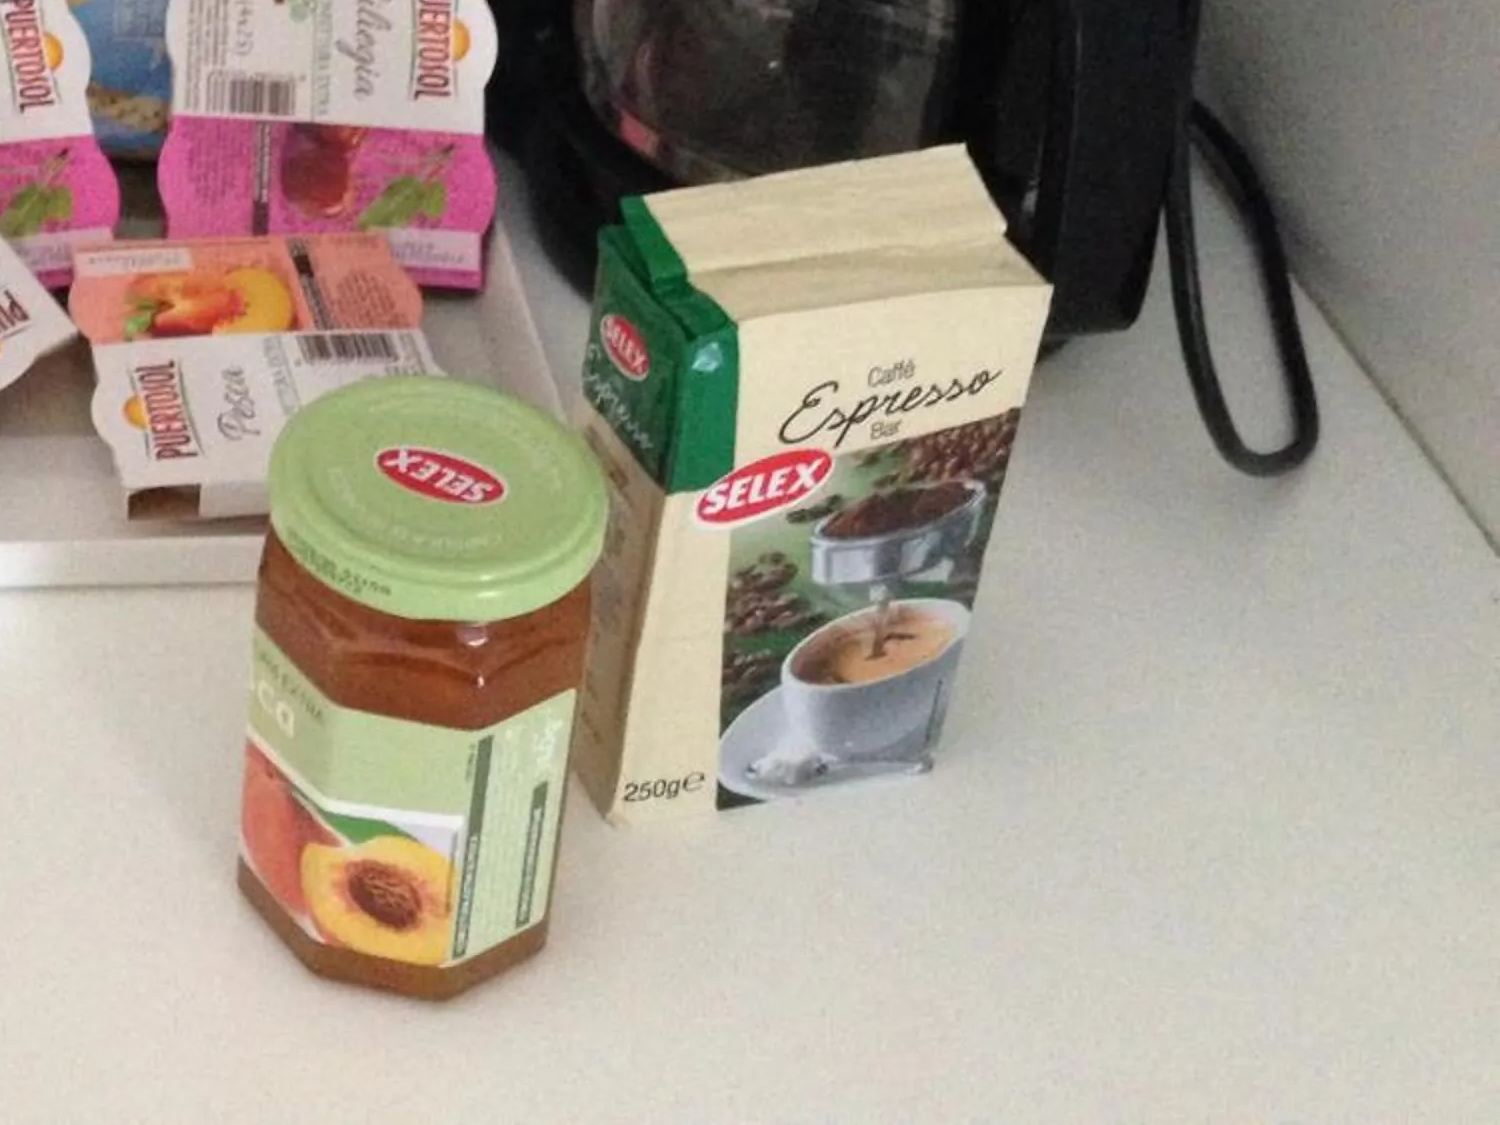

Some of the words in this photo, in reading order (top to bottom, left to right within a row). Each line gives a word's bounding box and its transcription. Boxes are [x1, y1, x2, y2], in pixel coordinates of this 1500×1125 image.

[603, 315, 648, 375] SELEX
[135, 359, 198, 462] PUERTOSOL
[217, 365, 261, 442] Pesca
[778, 368, 1003, 449] Espresso
[869, 418, 903, 441] Bar
[383, 448, 493, 506] SELEX
[700, 456, 828, 521] SELEX
